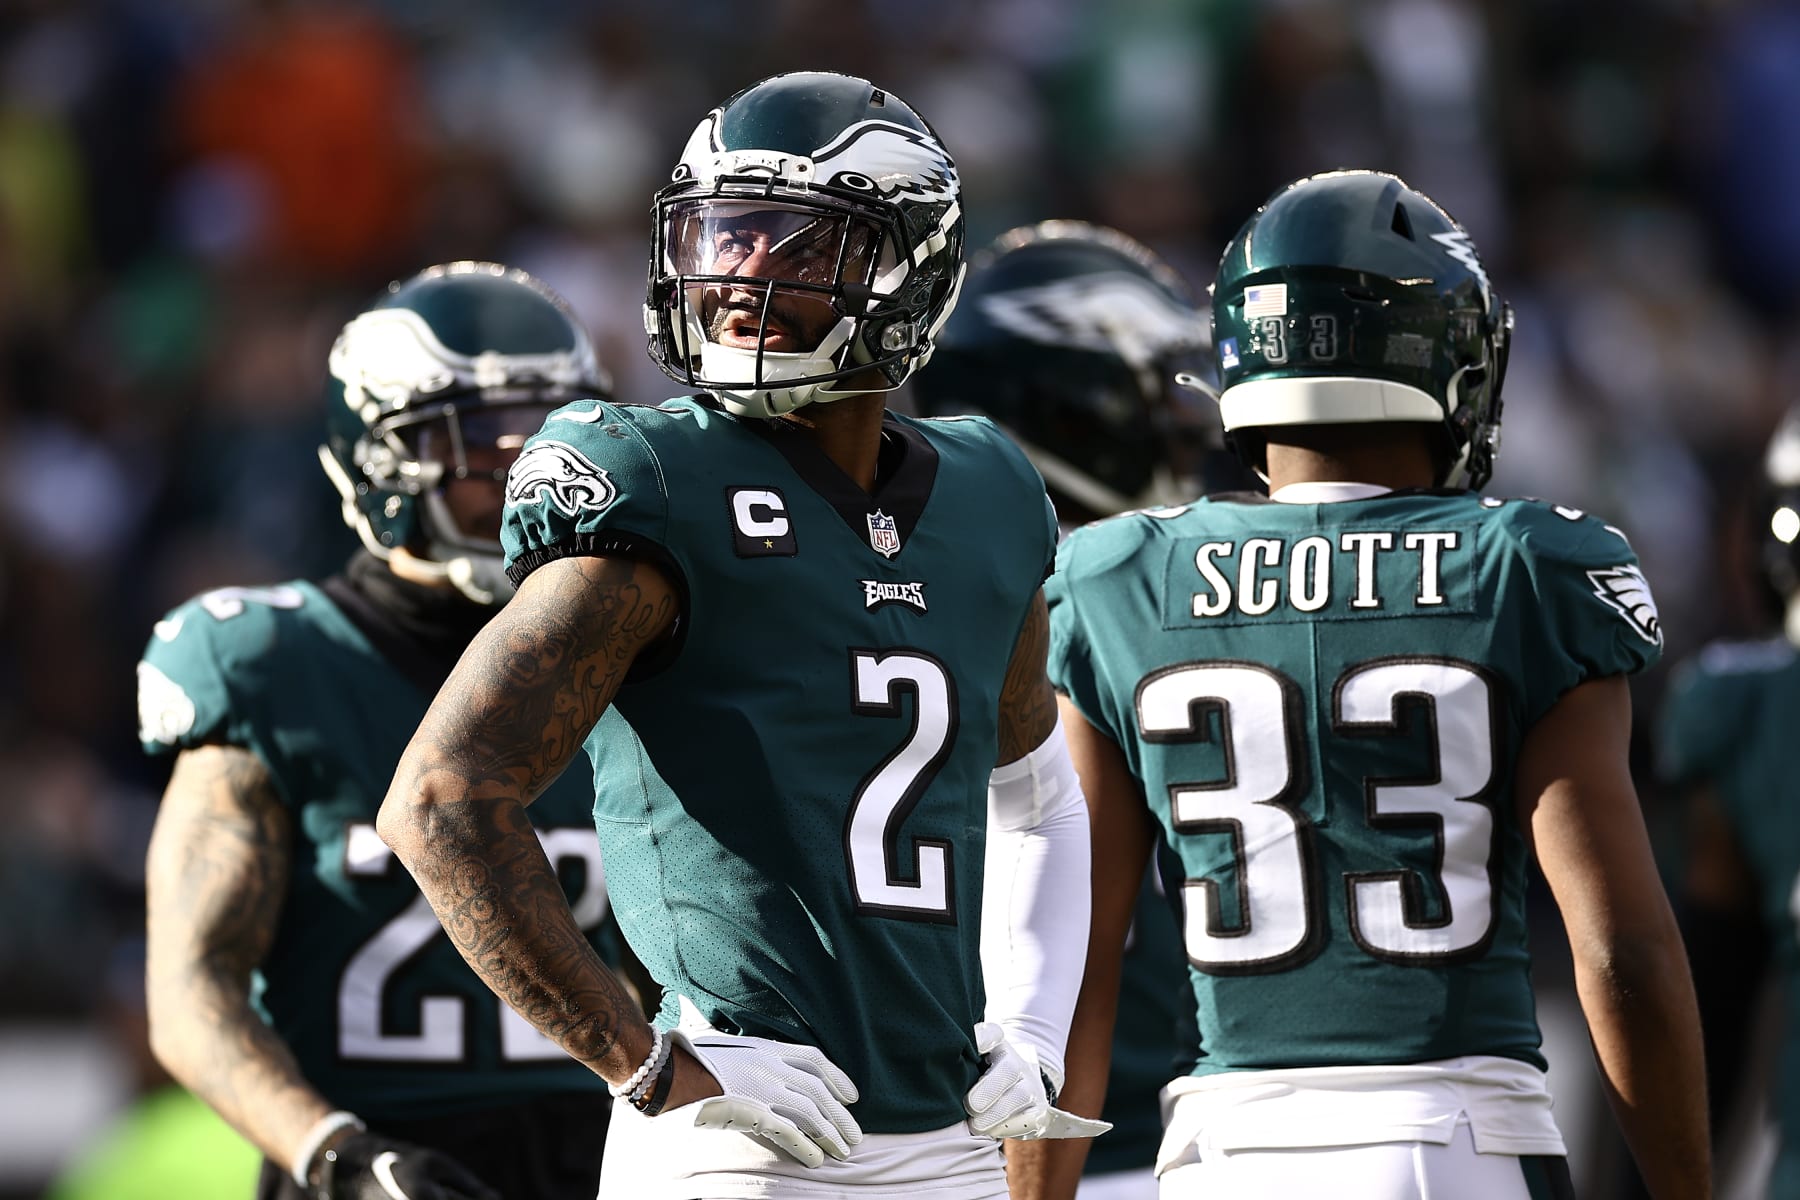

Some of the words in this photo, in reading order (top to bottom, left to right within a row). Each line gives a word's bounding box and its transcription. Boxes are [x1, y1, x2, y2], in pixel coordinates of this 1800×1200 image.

[1261, 314, 1339, 365] 33
[732, 489, 789, 538] C
[874, 530, 897, 548] NFL
[860, 580, 928, 611] EAGLES
[1192, 532, 1457, 617] SCOTT
[845, 650, 955, 917] 2
[1136, 656, 1499, 973] 33
